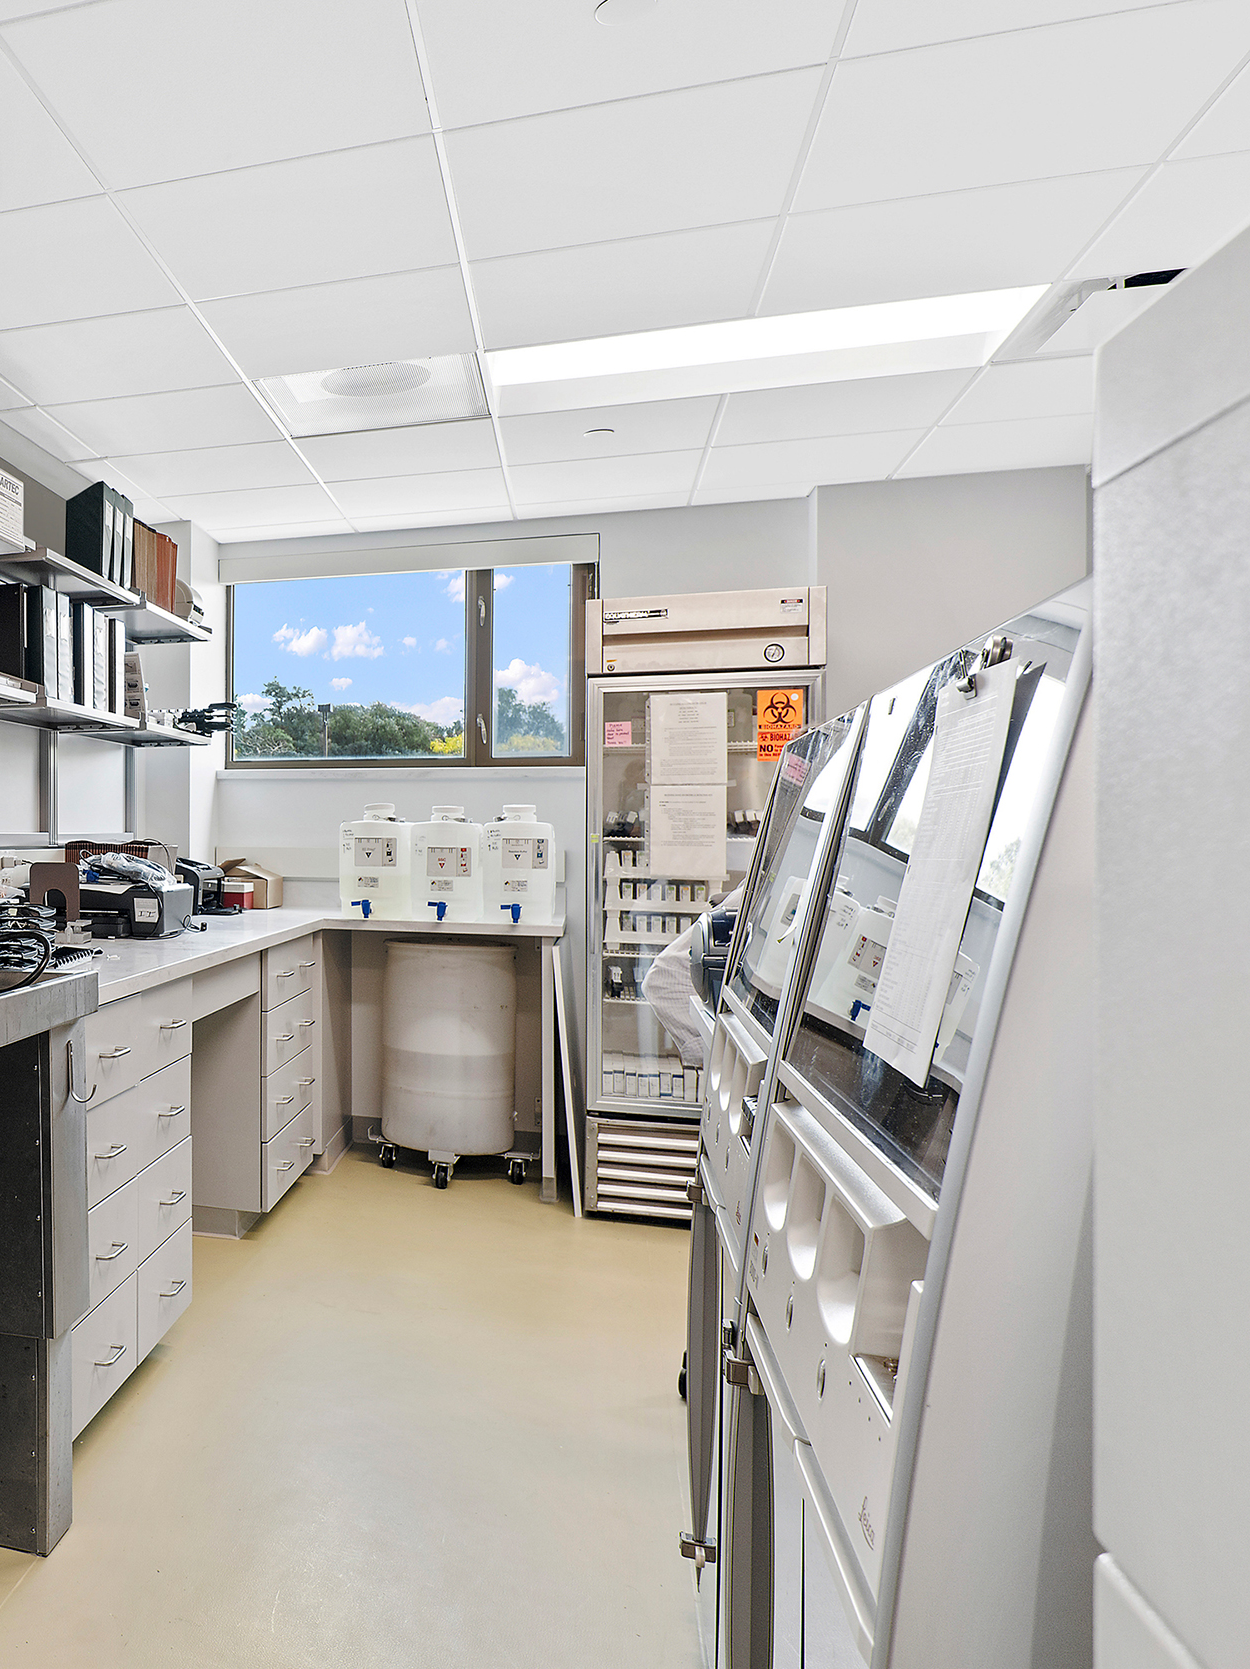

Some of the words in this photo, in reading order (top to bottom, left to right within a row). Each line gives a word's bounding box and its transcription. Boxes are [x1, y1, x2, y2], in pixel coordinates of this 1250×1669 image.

[0, 477, 20, 495] ARTEC
[769, 733, 796, 741] BIOHAZA
[759, 744, 773, 752] NO
